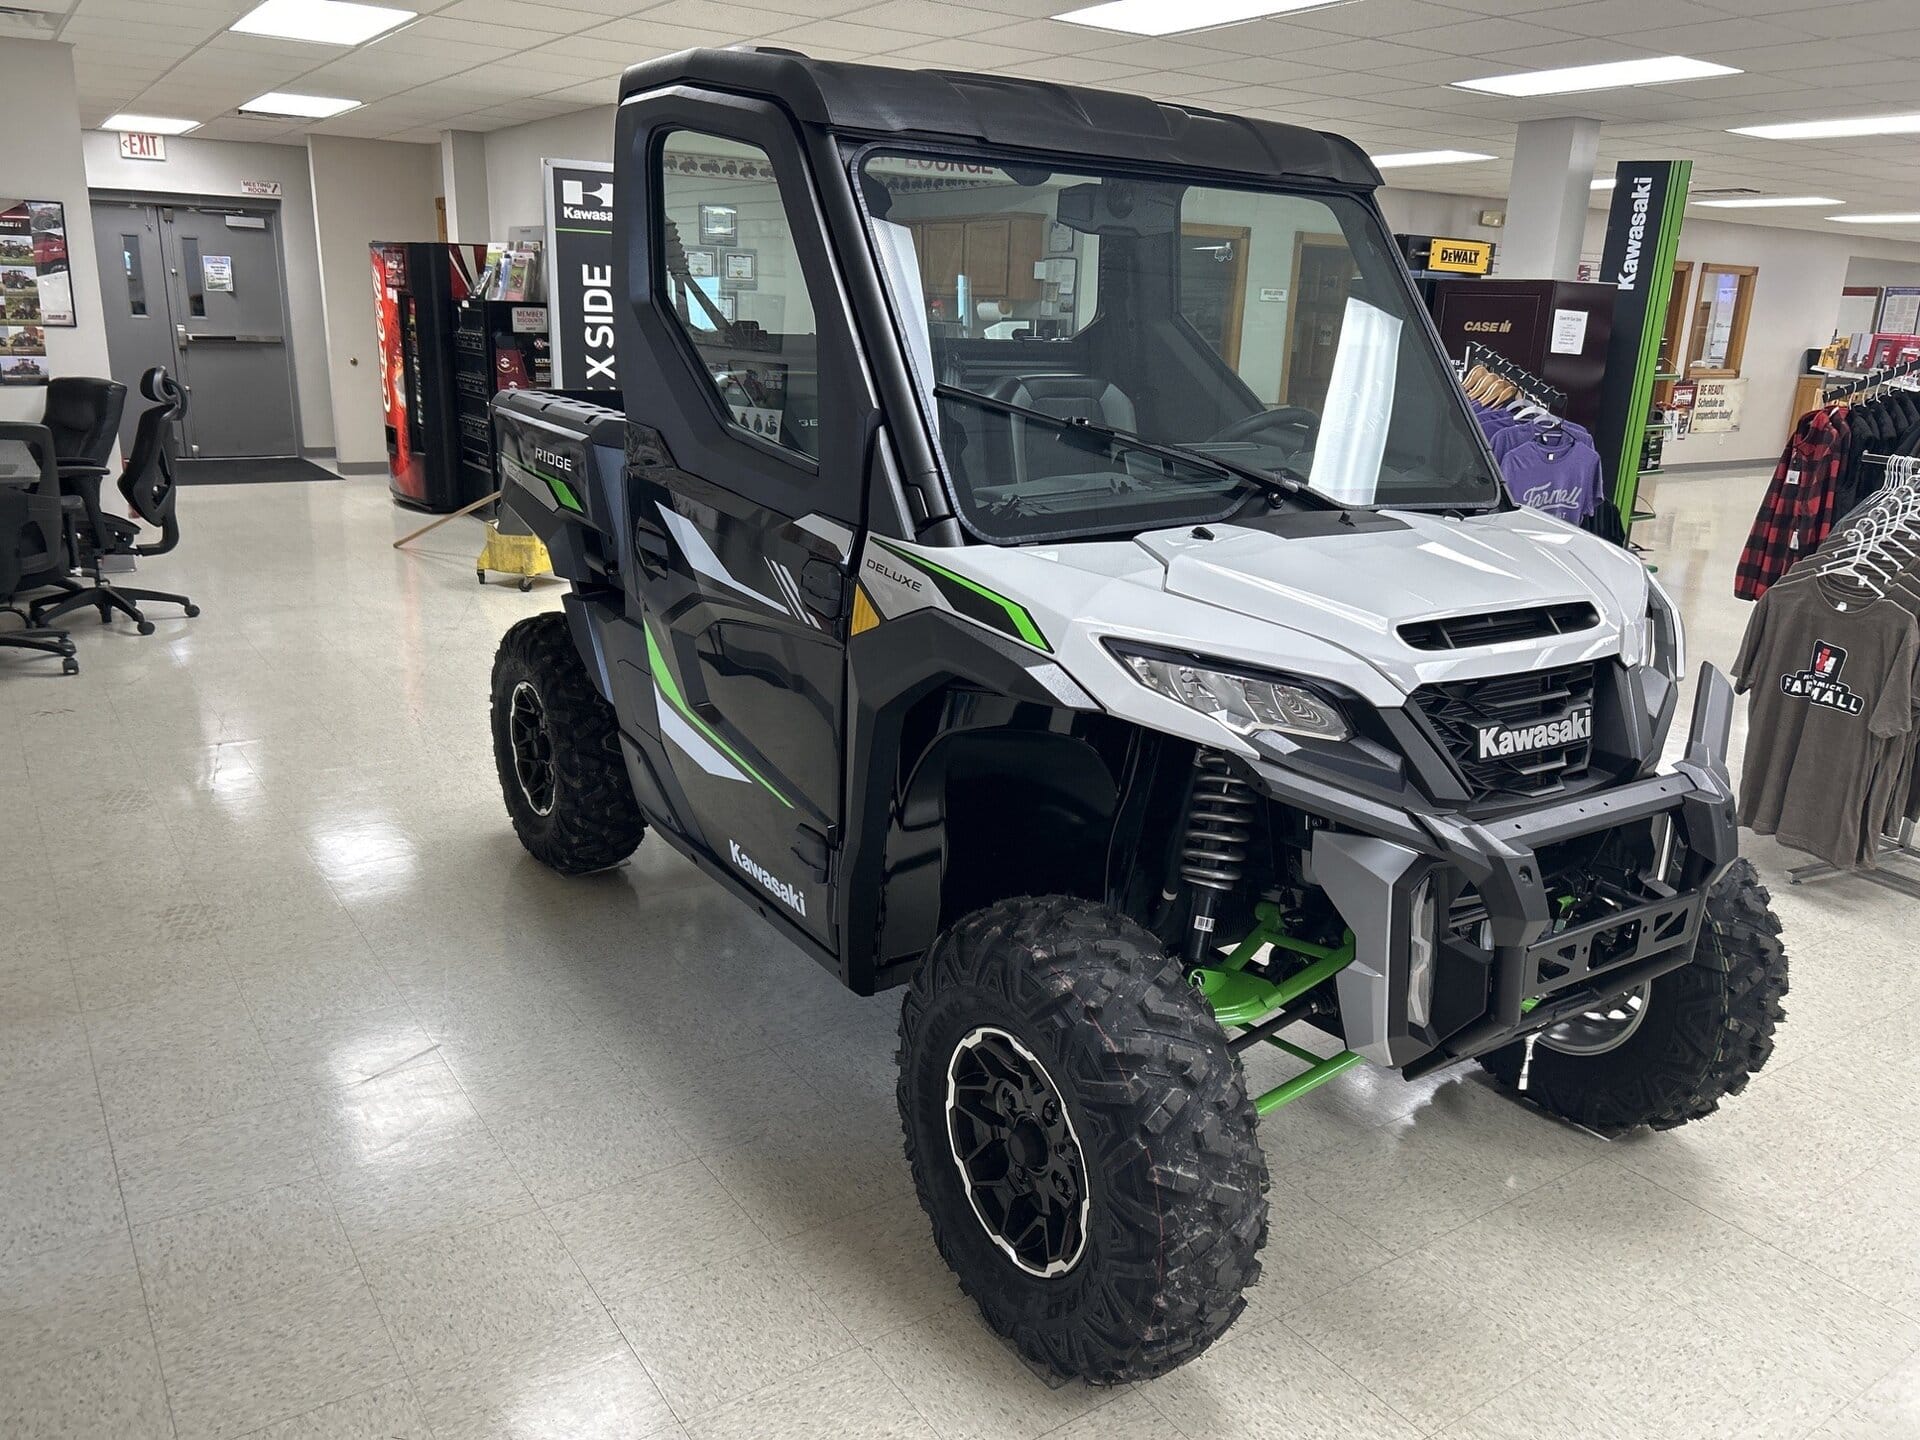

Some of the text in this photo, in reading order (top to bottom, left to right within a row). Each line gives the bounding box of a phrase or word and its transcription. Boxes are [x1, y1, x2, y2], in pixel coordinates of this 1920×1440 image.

[128, 133, 157, 156] EXIT
[243, 181, 271, 189] MEETING
[563, 206, 613, 222] Kawasa
[1617, 177, 1653, 291] Kawasaki
[516, 310, 544, 318] MEMBER
[581, 263, 615, 349] SIDE
[1463, 320, 1499, 332] CASE
[585, 354, 616, 381] X
[1700, 385, 1708, 395] BE
[1697, 398, 1718, 408] Schedule
[535, 447, 572, 472] RIDGE
[866, 558, 922, 593] DELUXE
[1479, 709, 1592, 759] Kawasaki
[729, 839, 807, 917] Kawasaki
